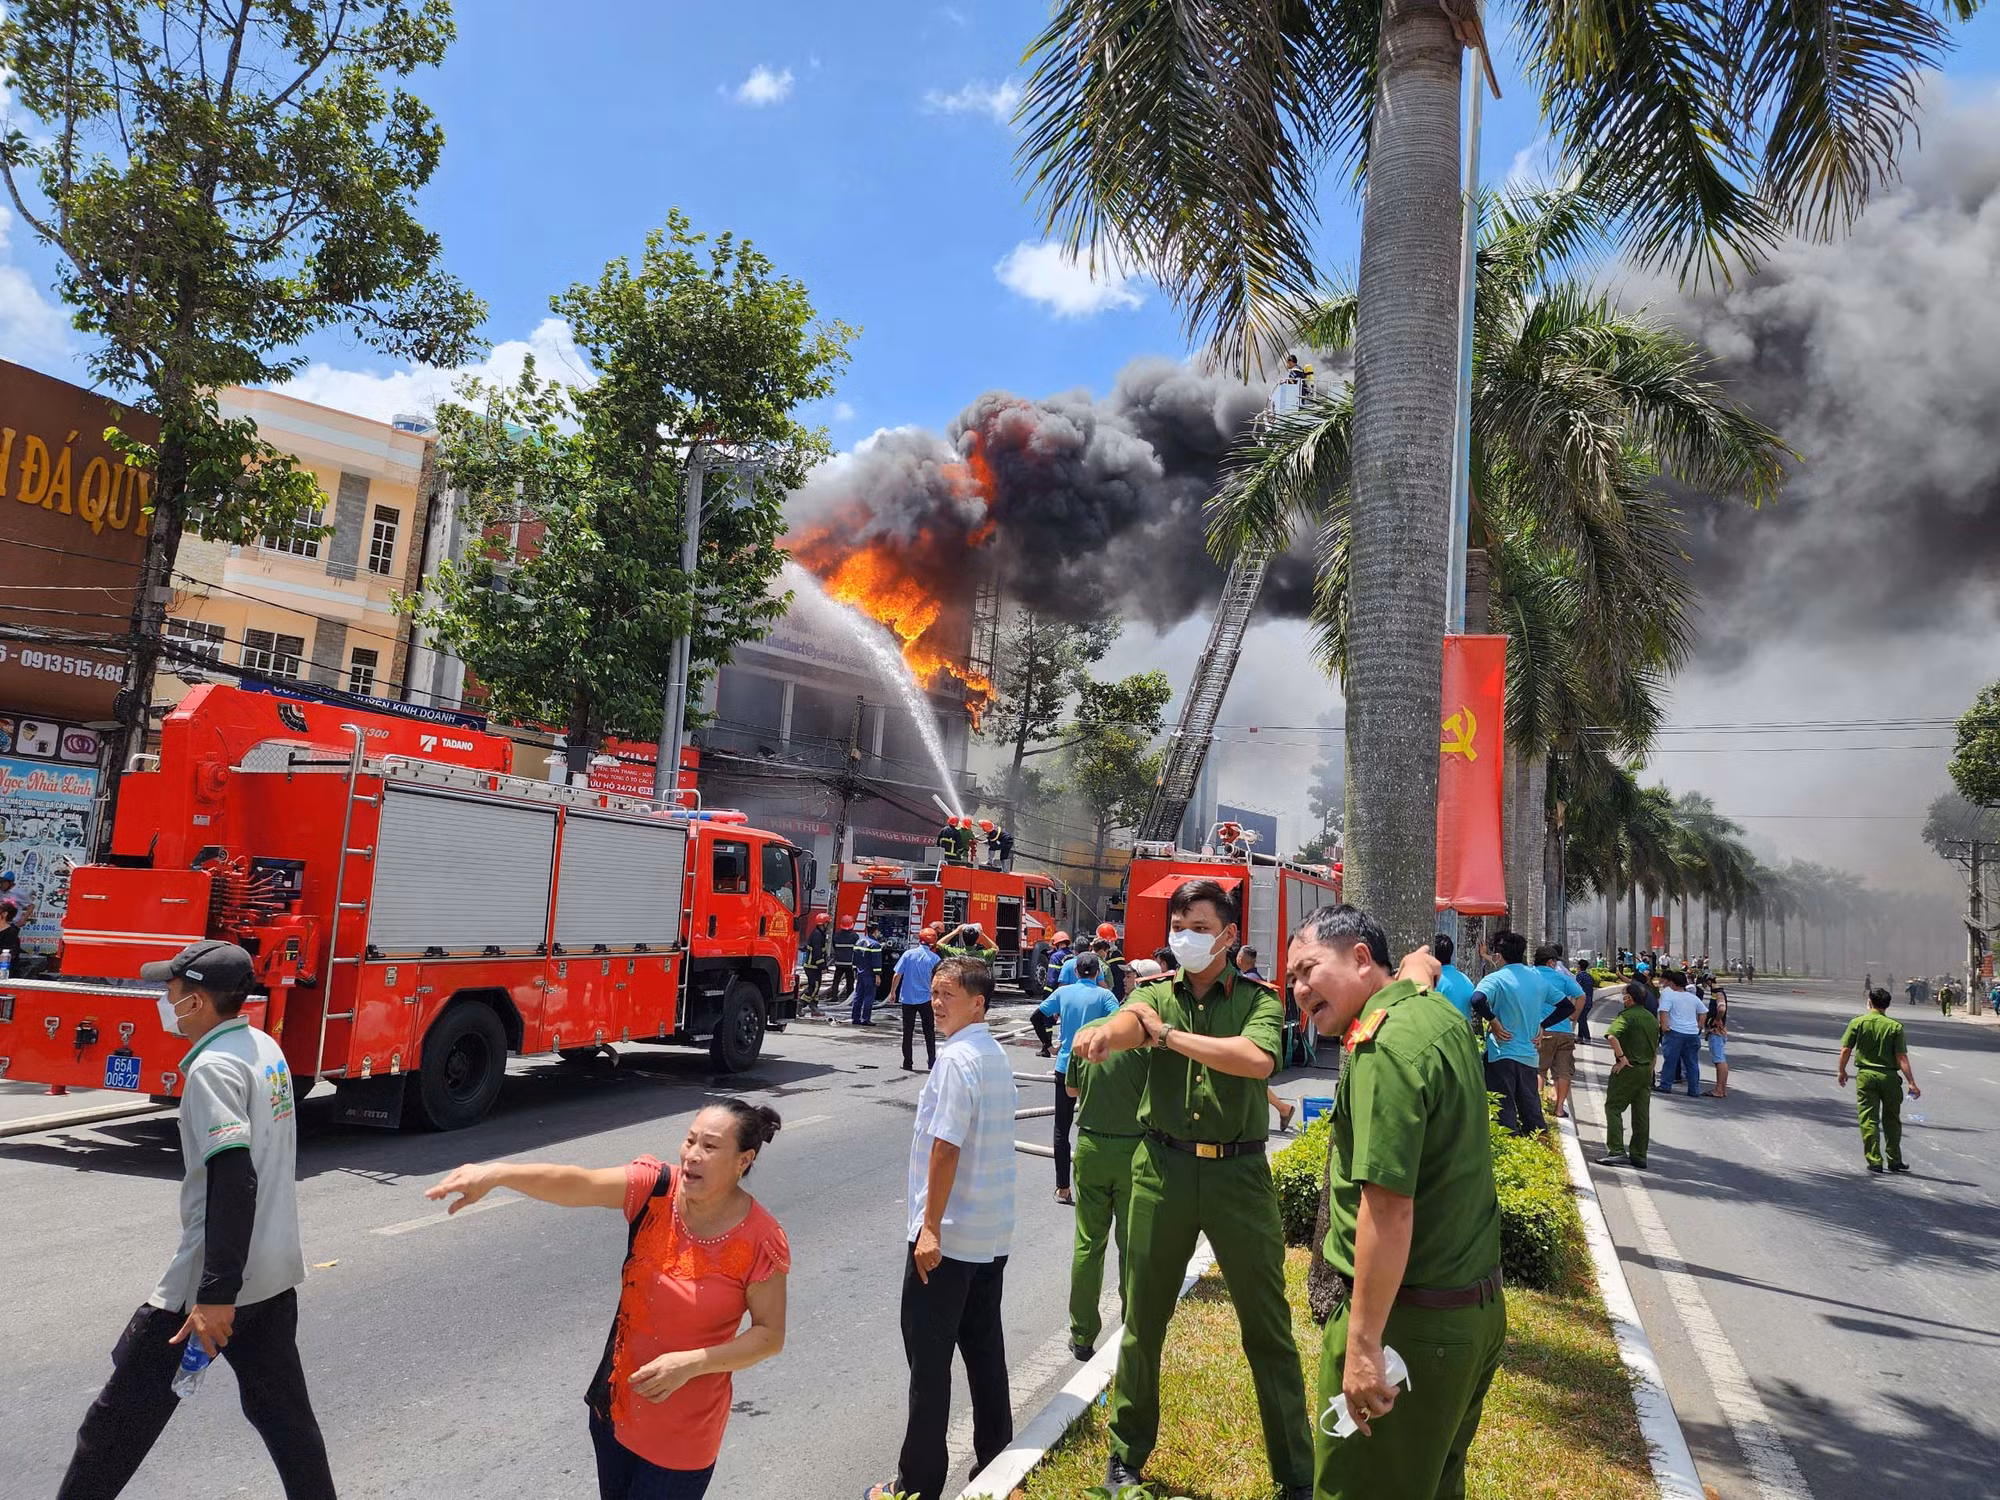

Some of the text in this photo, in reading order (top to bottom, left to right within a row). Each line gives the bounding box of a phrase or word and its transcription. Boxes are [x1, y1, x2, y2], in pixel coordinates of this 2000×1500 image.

[16, 430, 79, 515] ĐÁ
[393, 703, 417, 716] KINH
[420, 709, 456, 723] DOANH
[441, 738, 473, 752] TADANO
[62, 775, 91, 796] Linh
[799, 821, 819, 832] THU
[114, 1058, 132, 1072] 65A
[106, 1072, 138, 1087] 005.27
